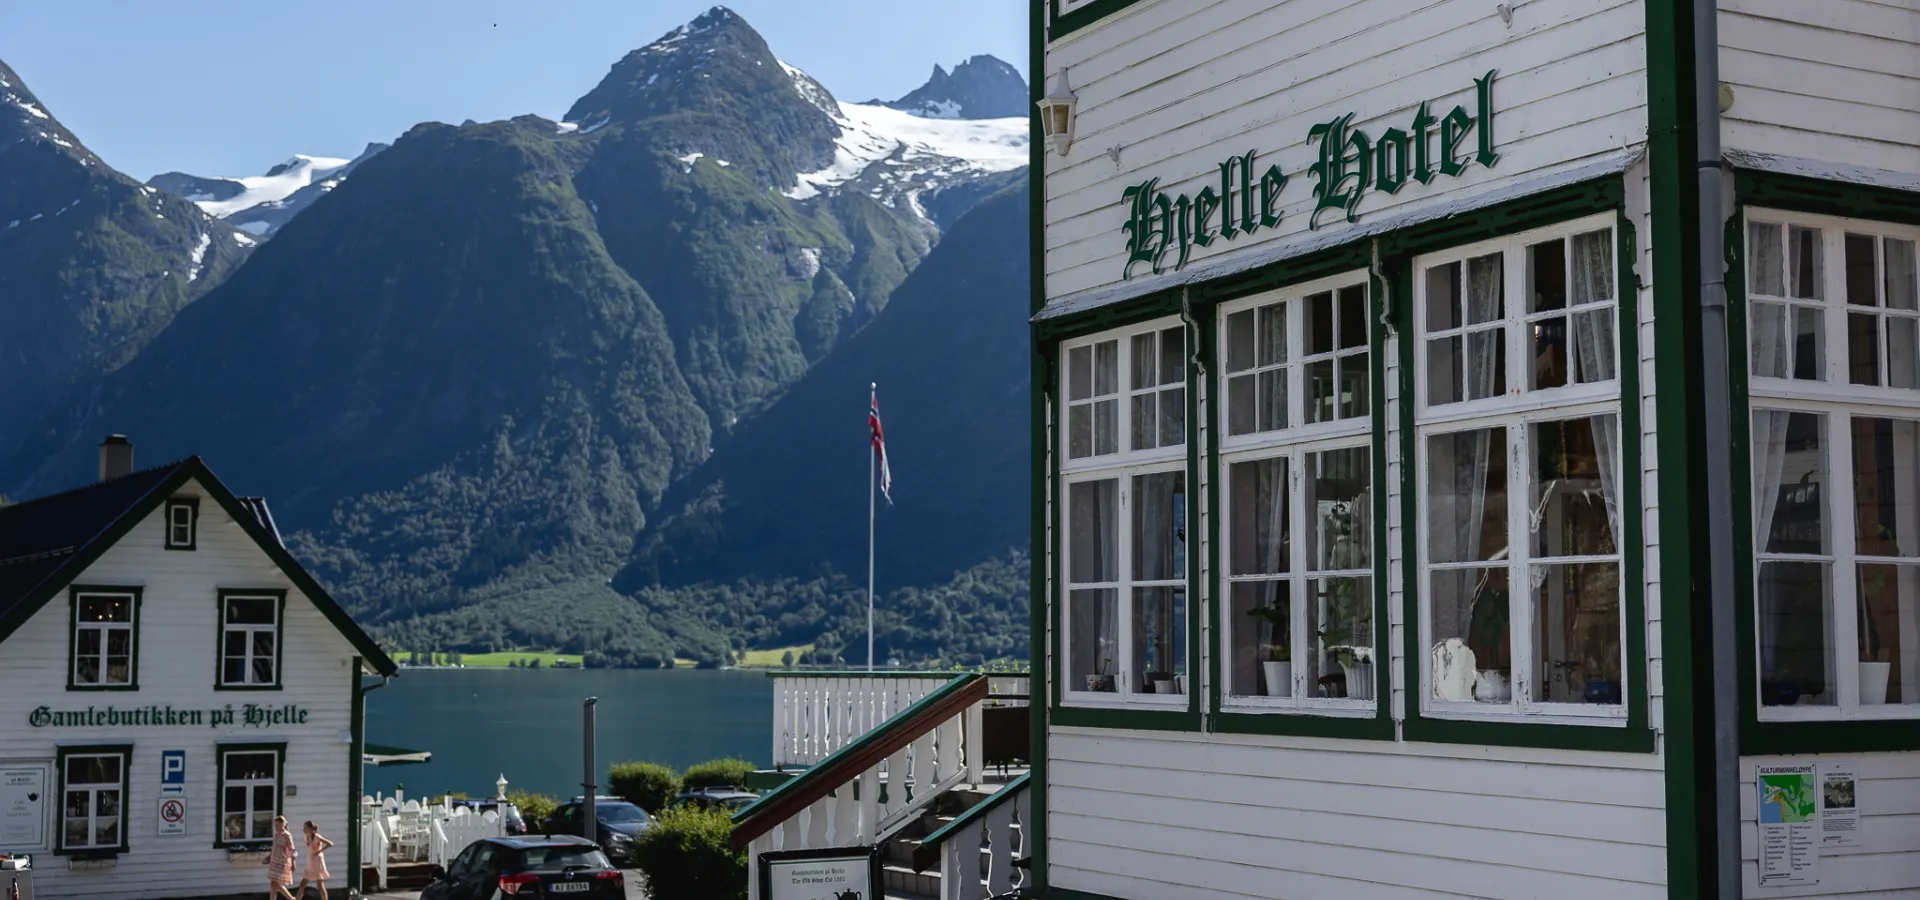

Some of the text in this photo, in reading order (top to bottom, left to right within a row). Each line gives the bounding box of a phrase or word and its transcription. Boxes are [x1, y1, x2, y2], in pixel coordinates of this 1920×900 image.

[1121, 69, 1499, 281] Hjelle Hotel
[29, 703, 307, 728] Gamlebutikken på Hjelle
[164, 756, 183, 781] P
